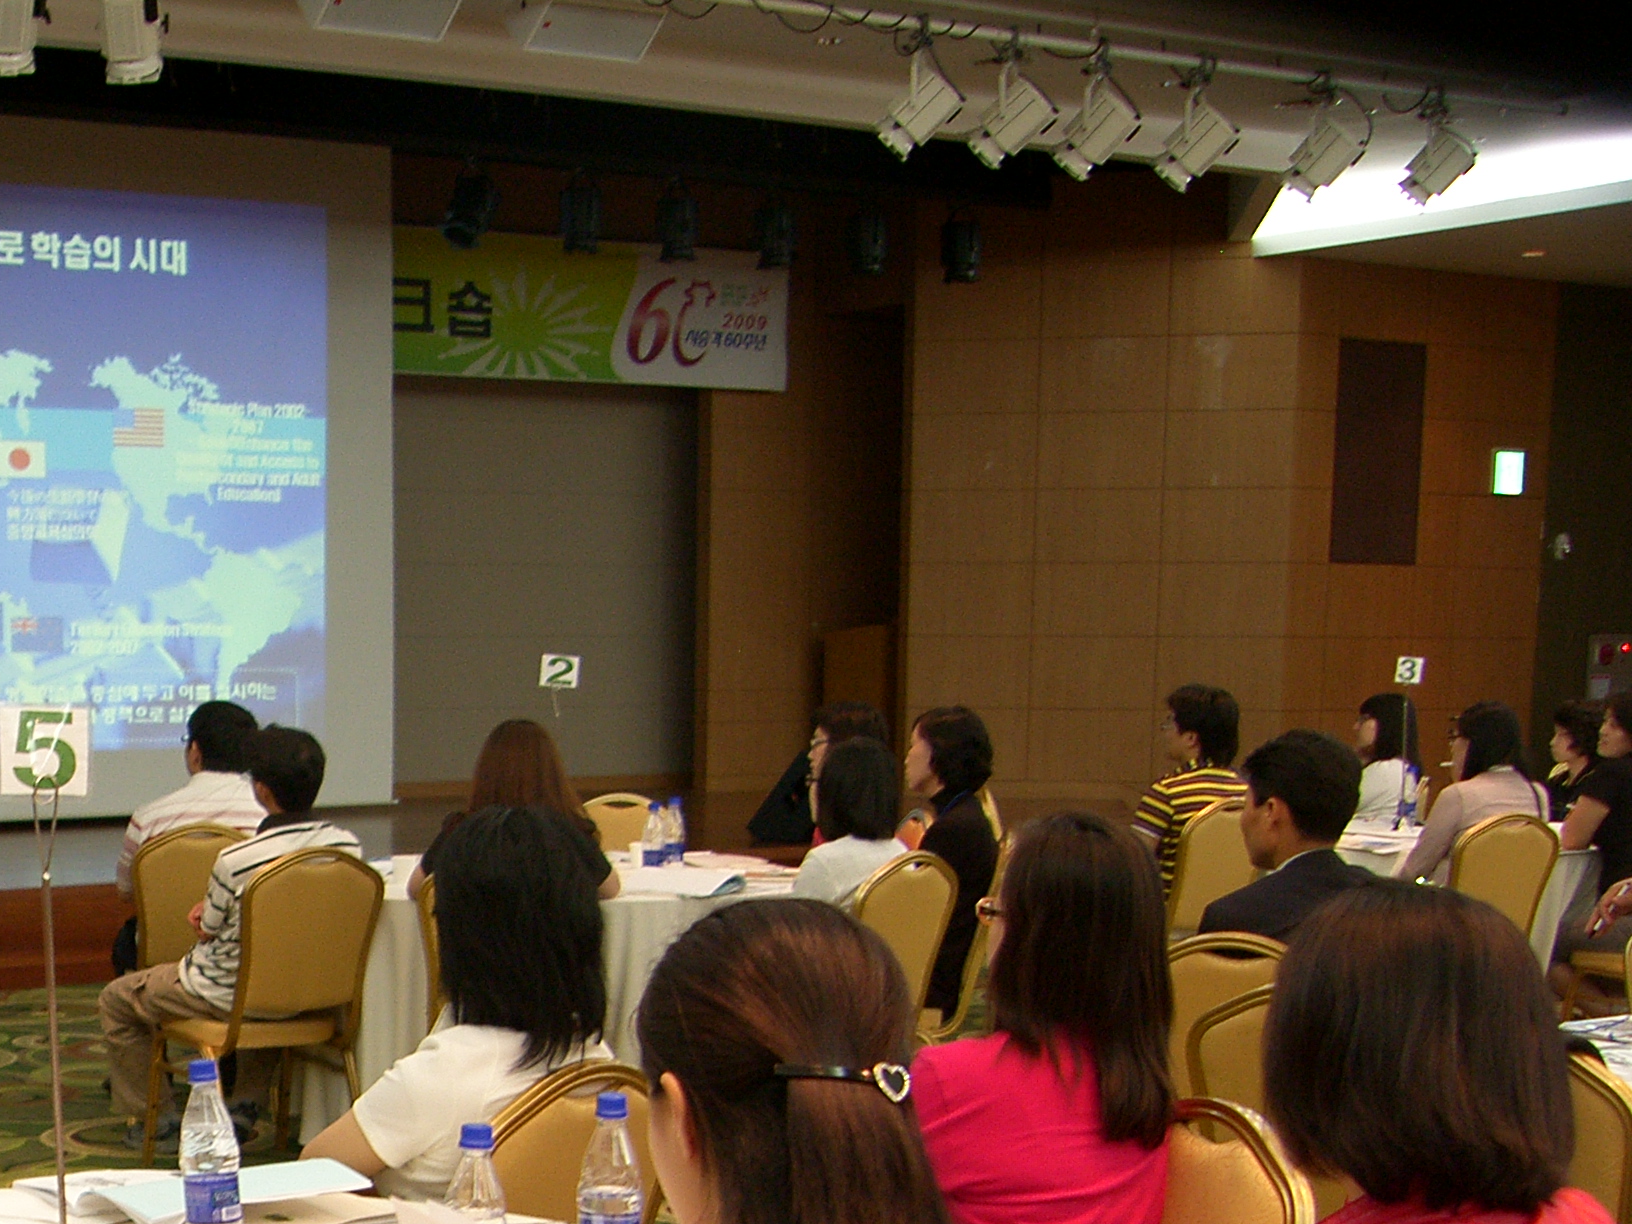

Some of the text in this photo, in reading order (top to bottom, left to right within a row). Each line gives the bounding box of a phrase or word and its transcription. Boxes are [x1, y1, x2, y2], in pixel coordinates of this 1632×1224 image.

[31, 230, 121, 273] 학습의
[129, 237, 189, 277] 시대
[546, 657, 573, 686] 2
[1398, 659, 1416, 681] 3
[13, 711, 76, 789] 5
